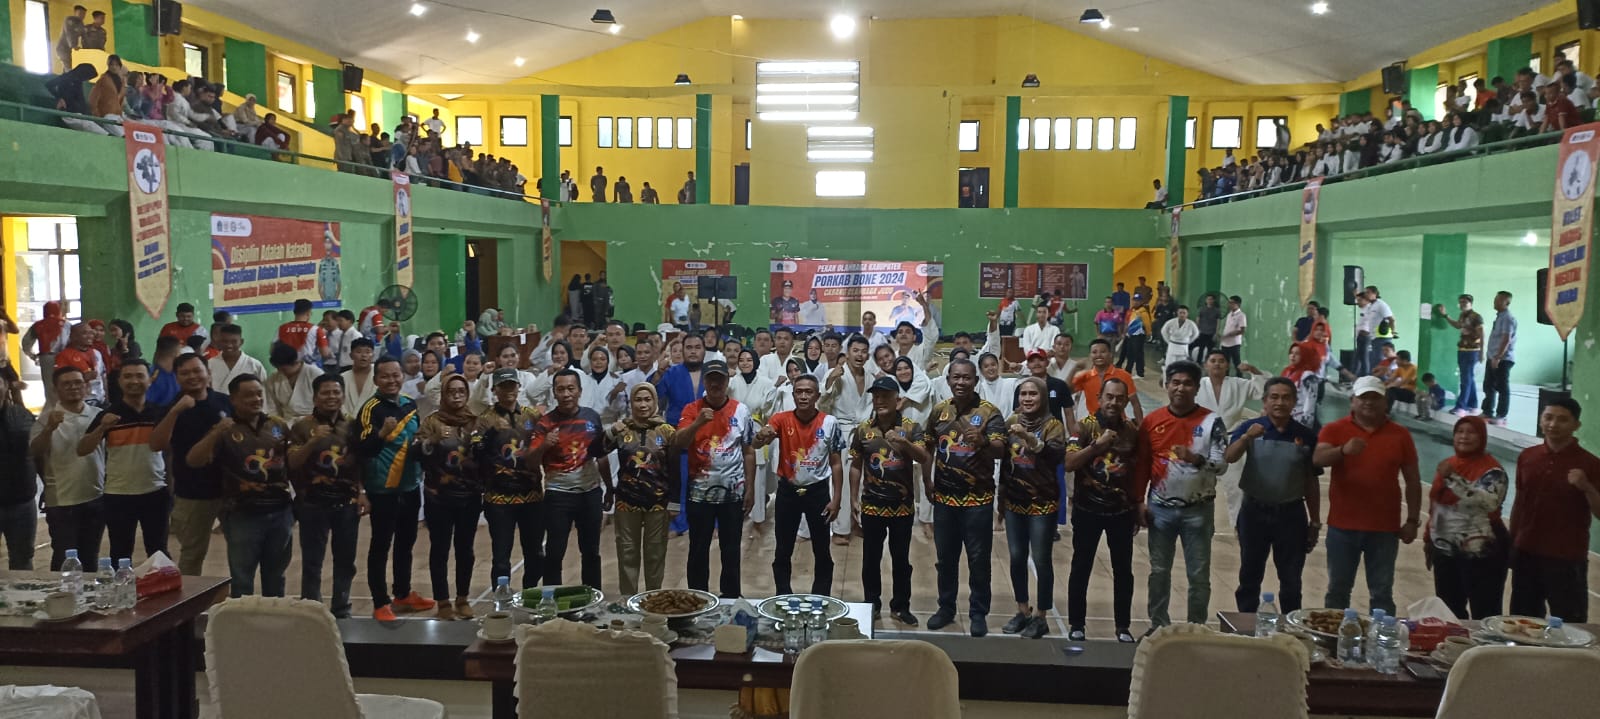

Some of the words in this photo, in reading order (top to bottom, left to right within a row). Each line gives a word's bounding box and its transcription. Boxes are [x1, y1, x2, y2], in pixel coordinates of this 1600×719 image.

[817, 264, 836, 272] PEKAN
[814, 274, 851, 287] PORKAB
[852, 273, 878, 286] BONE
[879, 272, 905, 285] 2024
